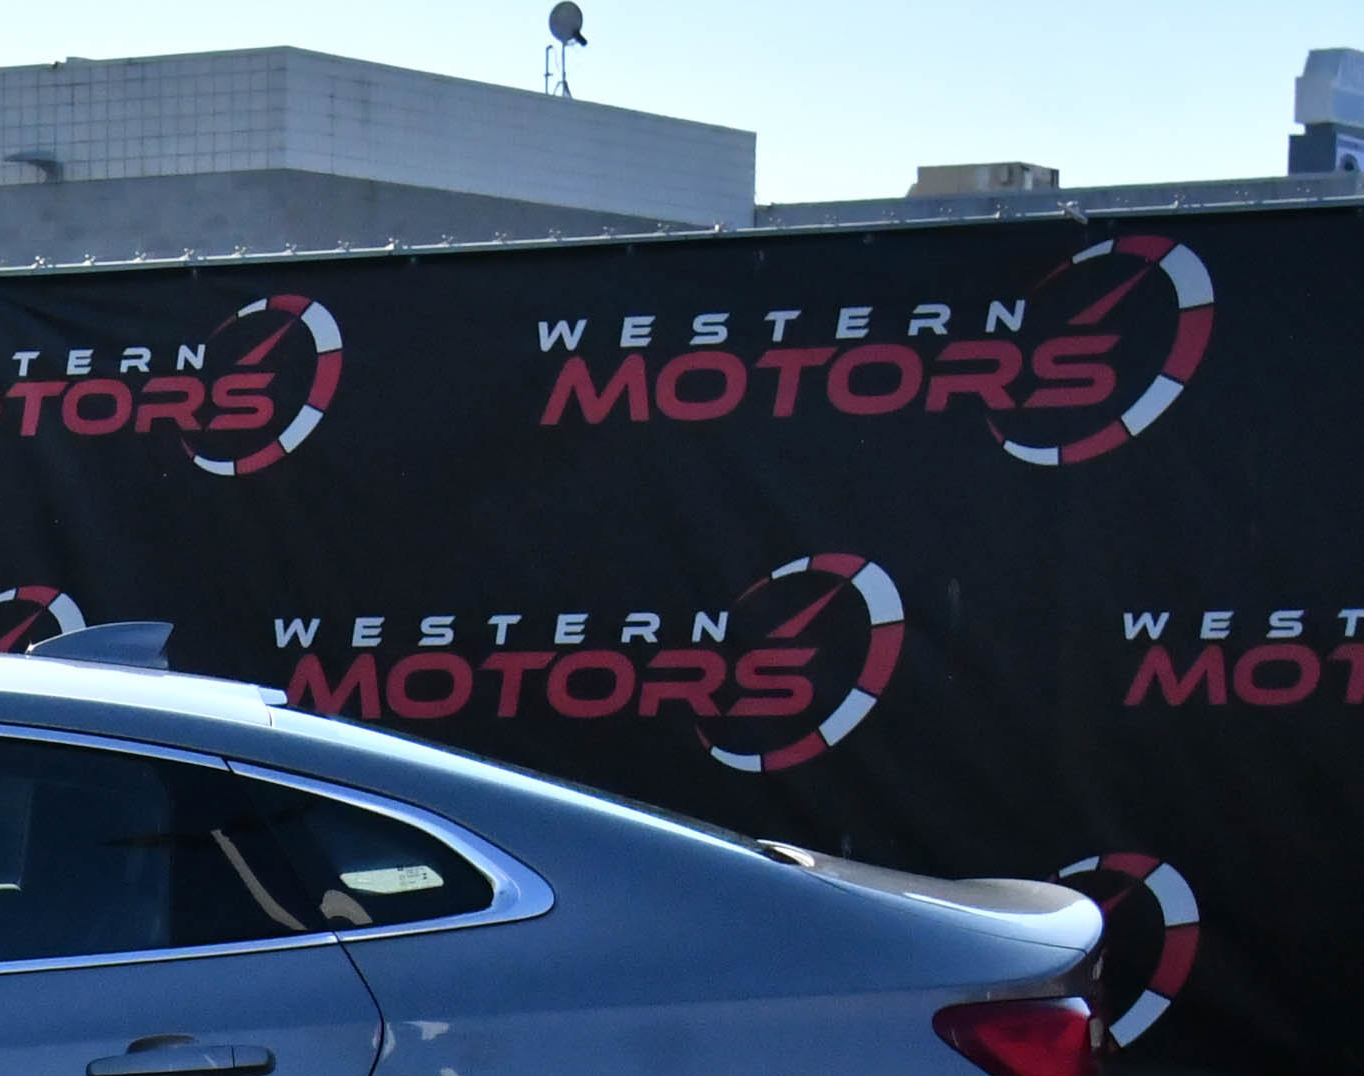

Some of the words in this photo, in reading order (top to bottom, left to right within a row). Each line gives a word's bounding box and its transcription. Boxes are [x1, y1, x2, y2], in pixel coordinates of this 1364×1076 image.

[538, 300, 1026, 351] WESTERN
[538, 334, 1122, 427] MOTORS
[274, 610, 730, 650] WESTERN
[285, 647, 819, 720] MOTORS
